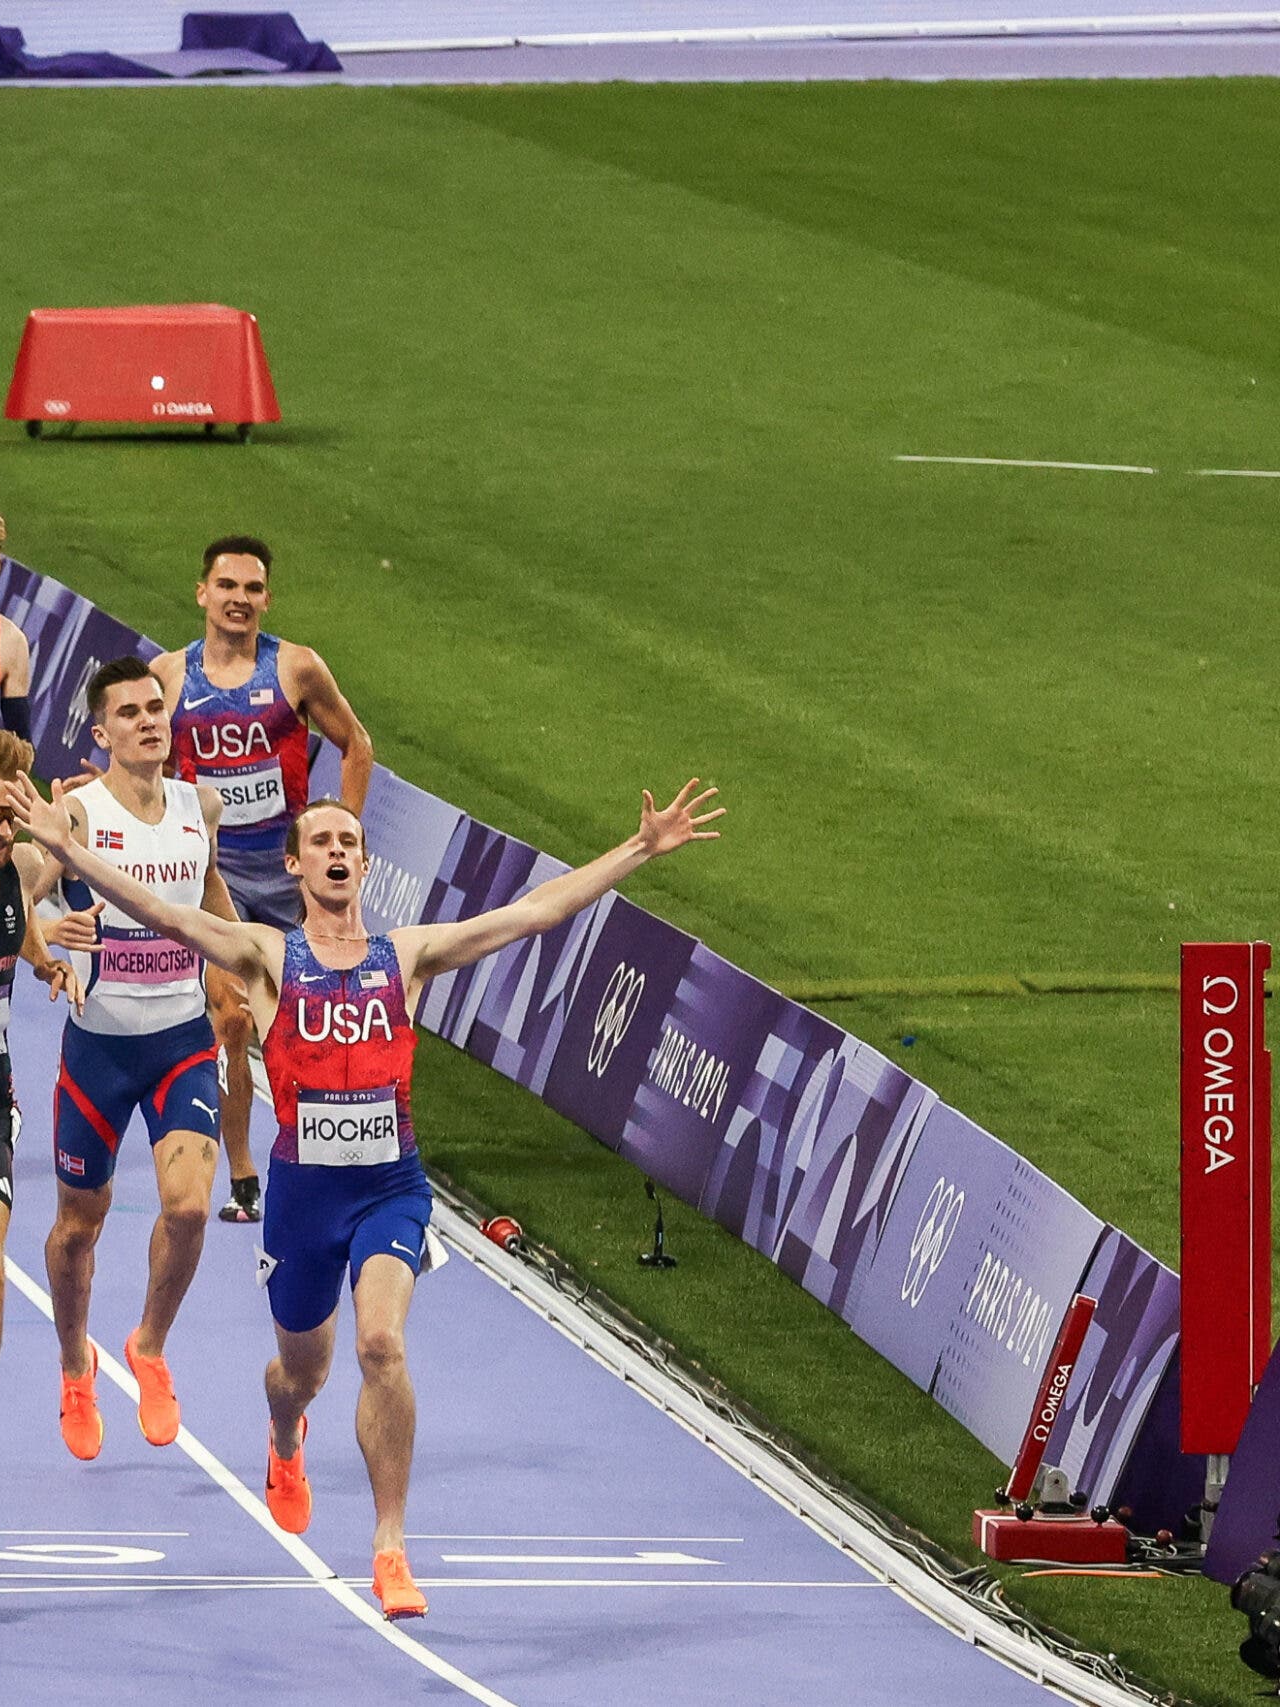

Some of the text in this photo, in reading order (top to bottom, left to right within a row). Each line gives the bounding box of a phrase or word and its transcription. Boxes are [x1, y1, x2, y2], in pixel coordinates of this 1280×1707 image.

[167, 402, 214, 415] OMEGA
[192, 721, 272, 760] USA
[217, 779, 280, 806] SSLER
[103, 948, 195, 974] INGEBRIGTSEN
[298, 998, 392, 1044] USA
[324, 1093, 376, 1101] PARIS 2024
[683, 1049, 730, 1123] 2024
[1203, 1028, 1235, 1175] OMEGA
[303, 1115, 394, 1142] HOCKER
[1006, 1286, 1054, 1374] 2024
[1041, 1364, 1072, 1422] OMEGA
